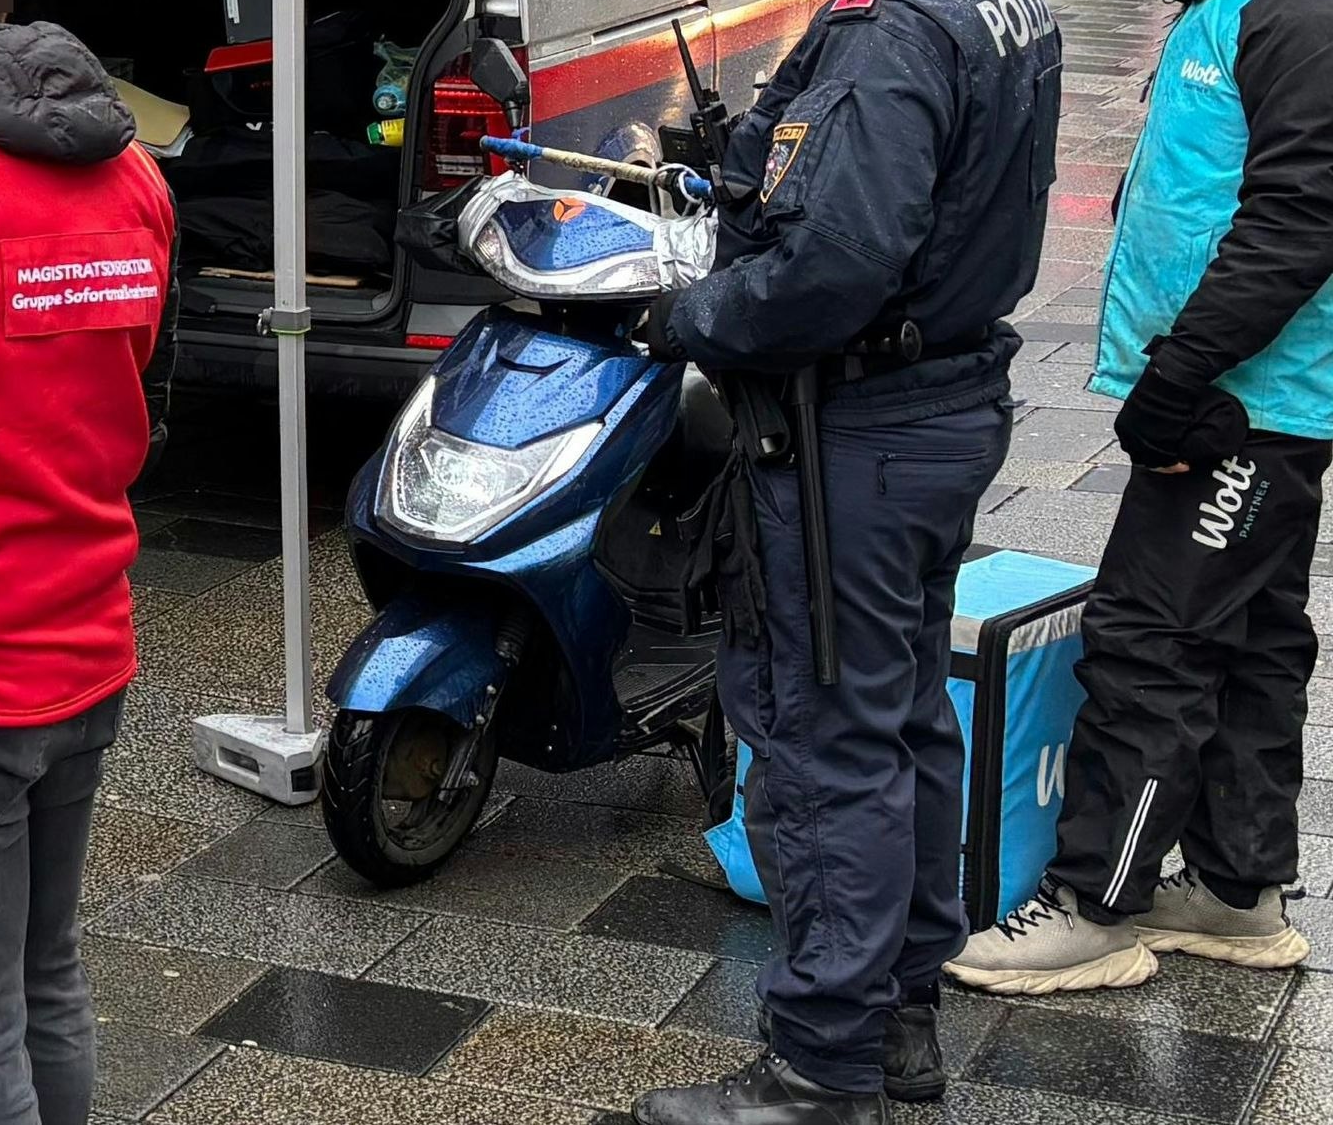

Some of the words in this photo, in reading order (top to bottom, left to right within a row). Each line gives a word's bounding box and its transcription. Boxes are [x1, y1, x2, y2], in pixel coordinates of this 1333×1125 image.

[1181, 58, 1222, 87] Wolt
[12, 292, 63, 312] Gruppe
[1191, 455, 1257, 550] Wolt
[1238, 479, 1272, 539] PARTNER
